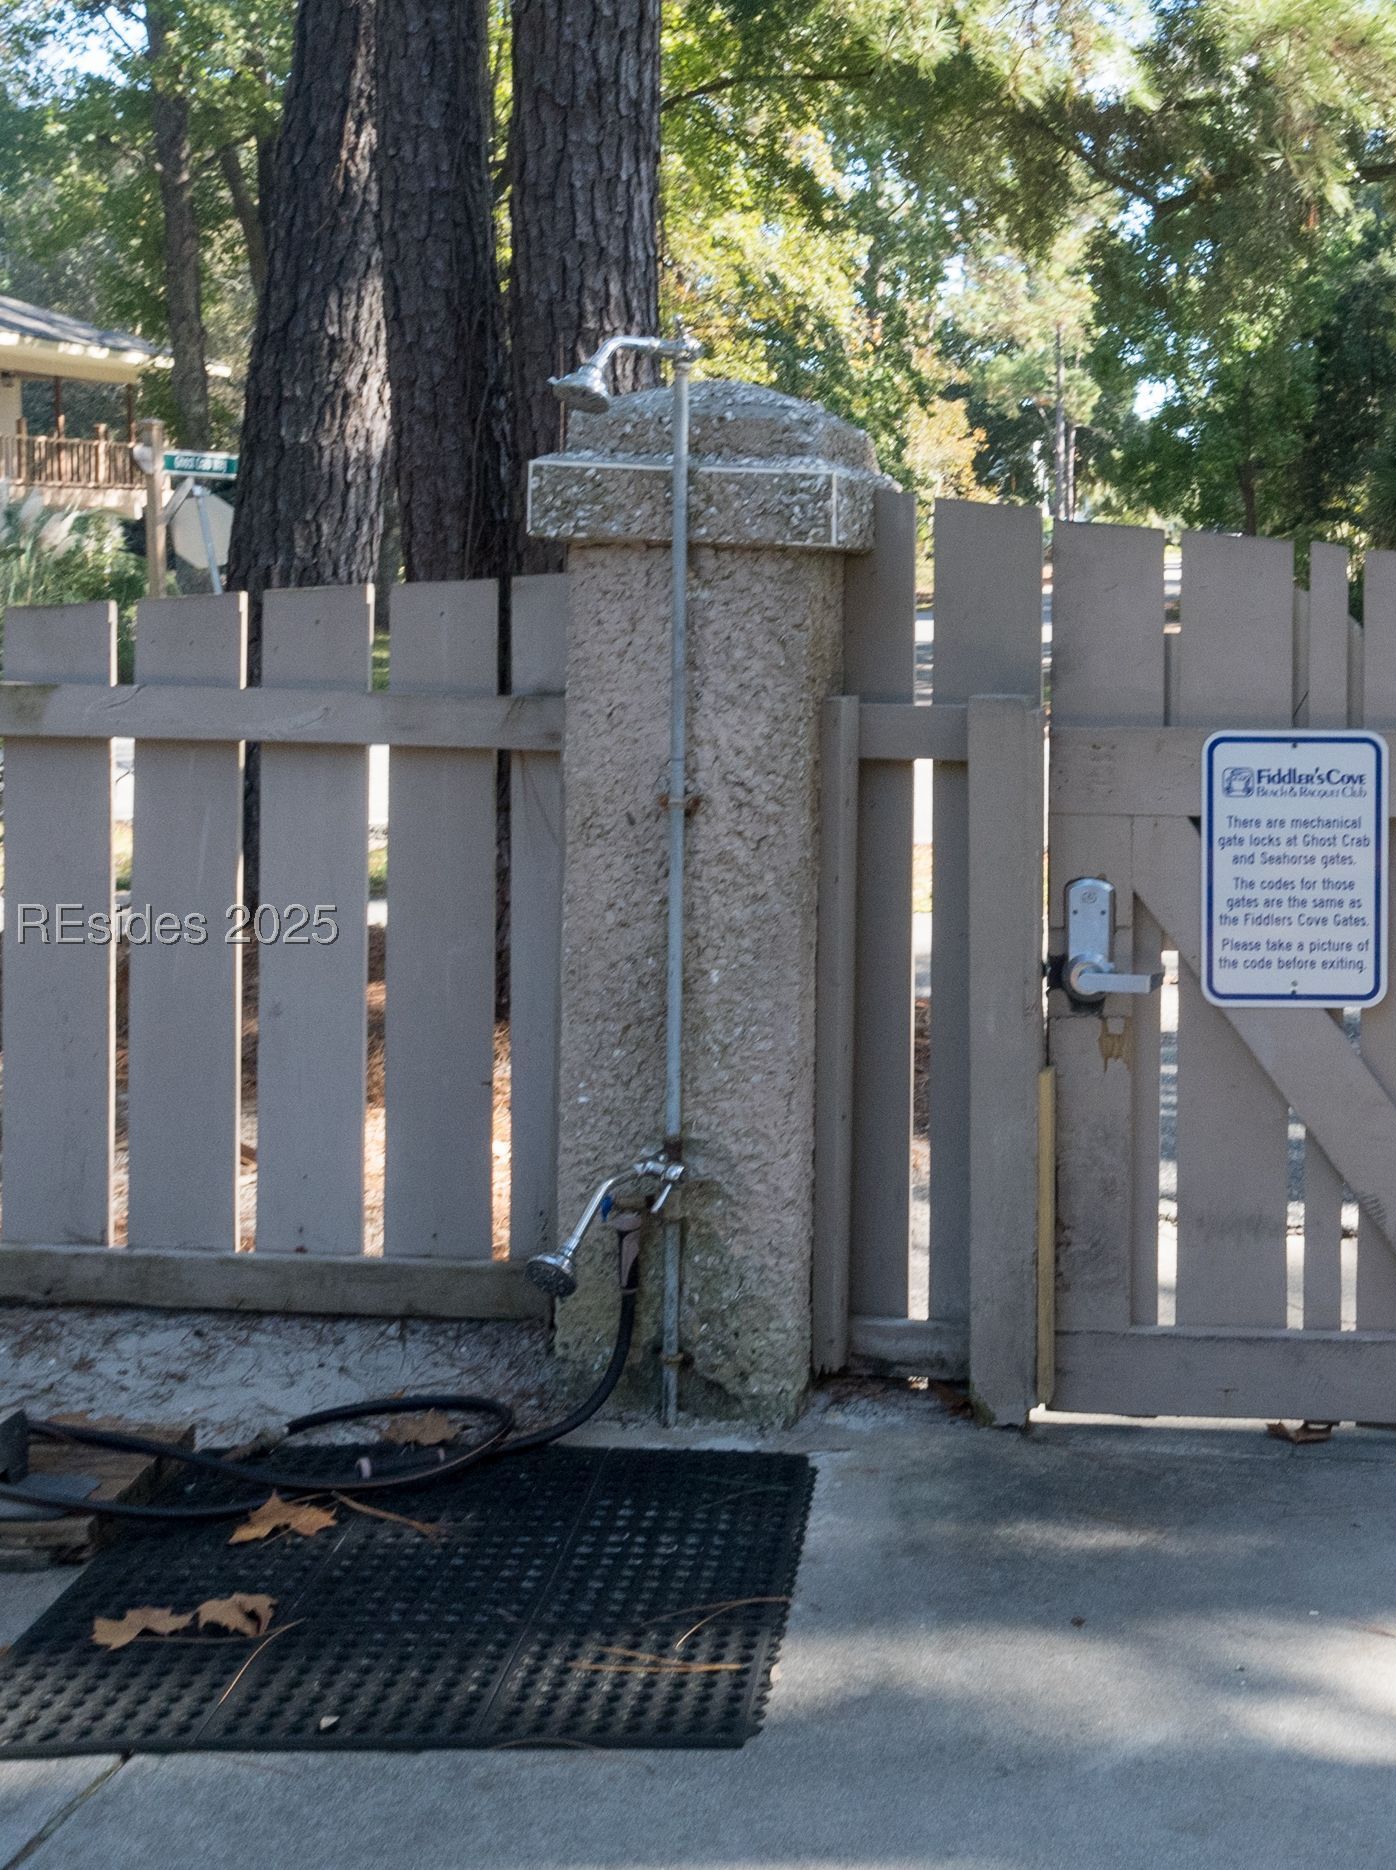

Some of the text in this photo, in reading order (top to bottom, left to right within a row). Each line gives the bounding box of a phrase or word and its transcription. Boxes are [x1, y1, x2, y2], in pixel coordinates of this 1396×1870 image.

[1226, 815, 1362, 829] There are mechanical
[1217, 833, 1371, 850] gate locks at Ghost Crab
[1232, 851, 1357, 869] and Seahorse gates.
[1233, 876, 1355, 891] The codes for those
[1226, 895, 1363, 912] gates are the same as
[1218, 913, 1370, 927] the Fiddlers Cove Gates.
[1221, 937, 1370, 954] Please take a picture of
[1218, 956, 1367, 974] the code before exiting.
